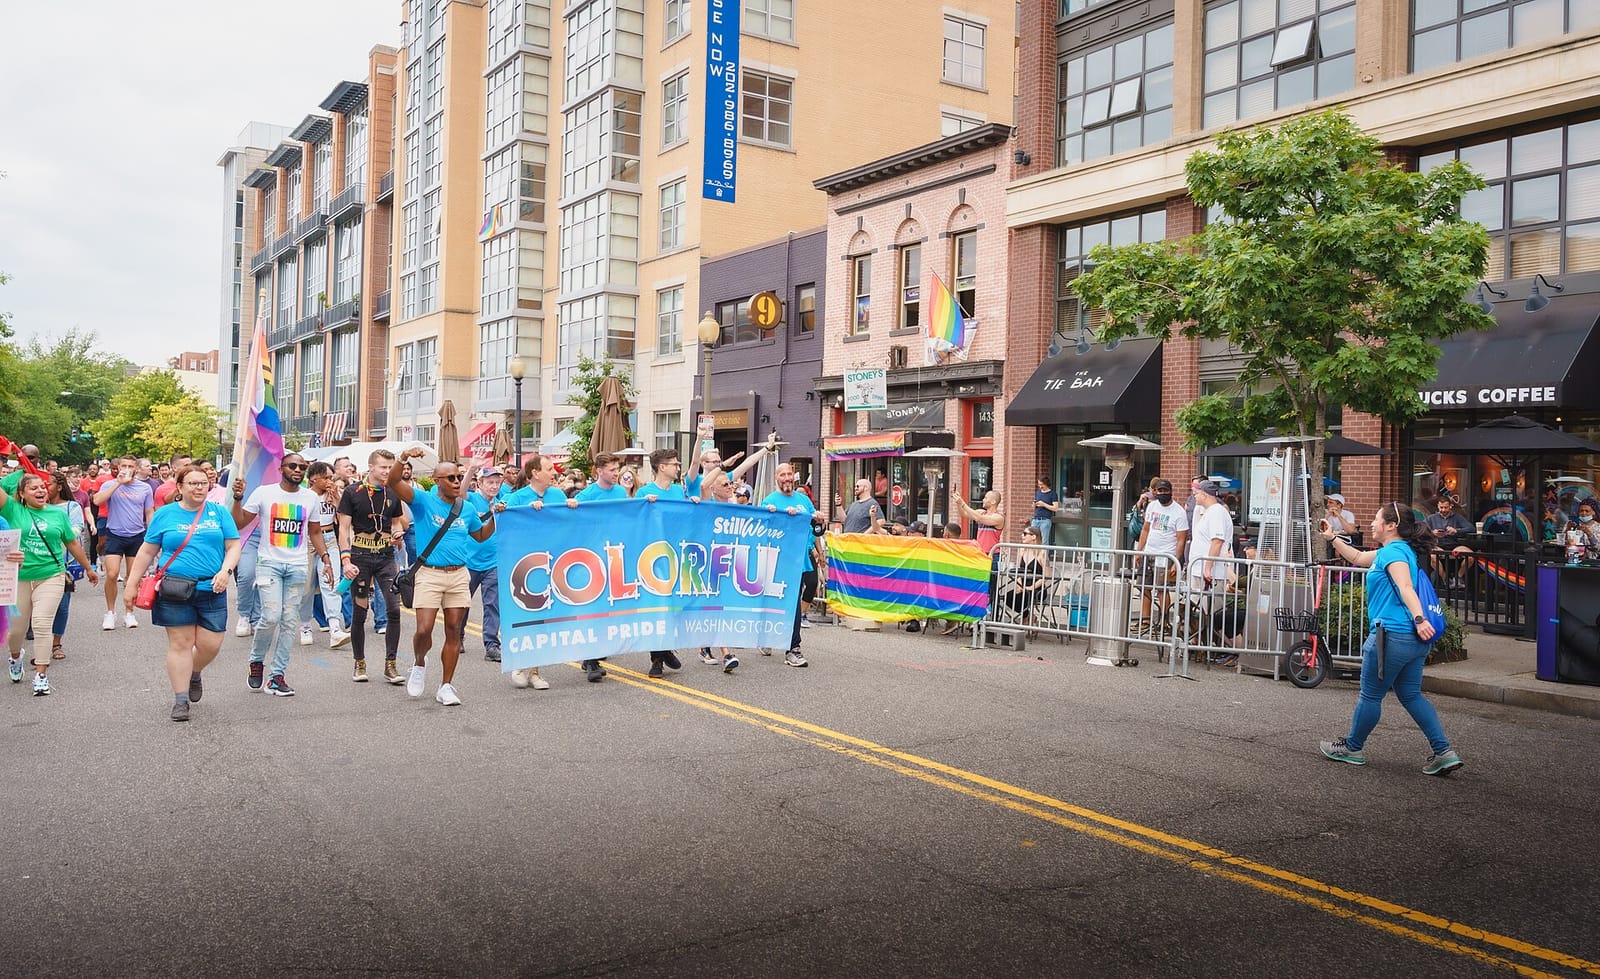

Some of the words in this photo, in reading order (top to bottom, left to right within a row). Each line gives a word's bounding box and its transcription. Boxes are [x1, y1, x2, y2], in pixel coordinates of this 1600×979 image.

[710, 33, 723, 77] NOW
[757, 295, 776, 325] 9
[847, 369, 884, 383] STONEY'S
[1044, 379, 1066, 390] TIE
[1070, 376, 1104, 389] BAR
[1478, 386, 1556, 404] COFFEE
[886, 405, 926, 419] STONEY'S
[274, 518, 302, 534] PRIDE
[510, 538, 787, 612] COLORFUL
[509, 628, 598, 653] CAPITAL
[607, 620, 667, 641] PRIDE
[764, 621, 785, 635] DC
